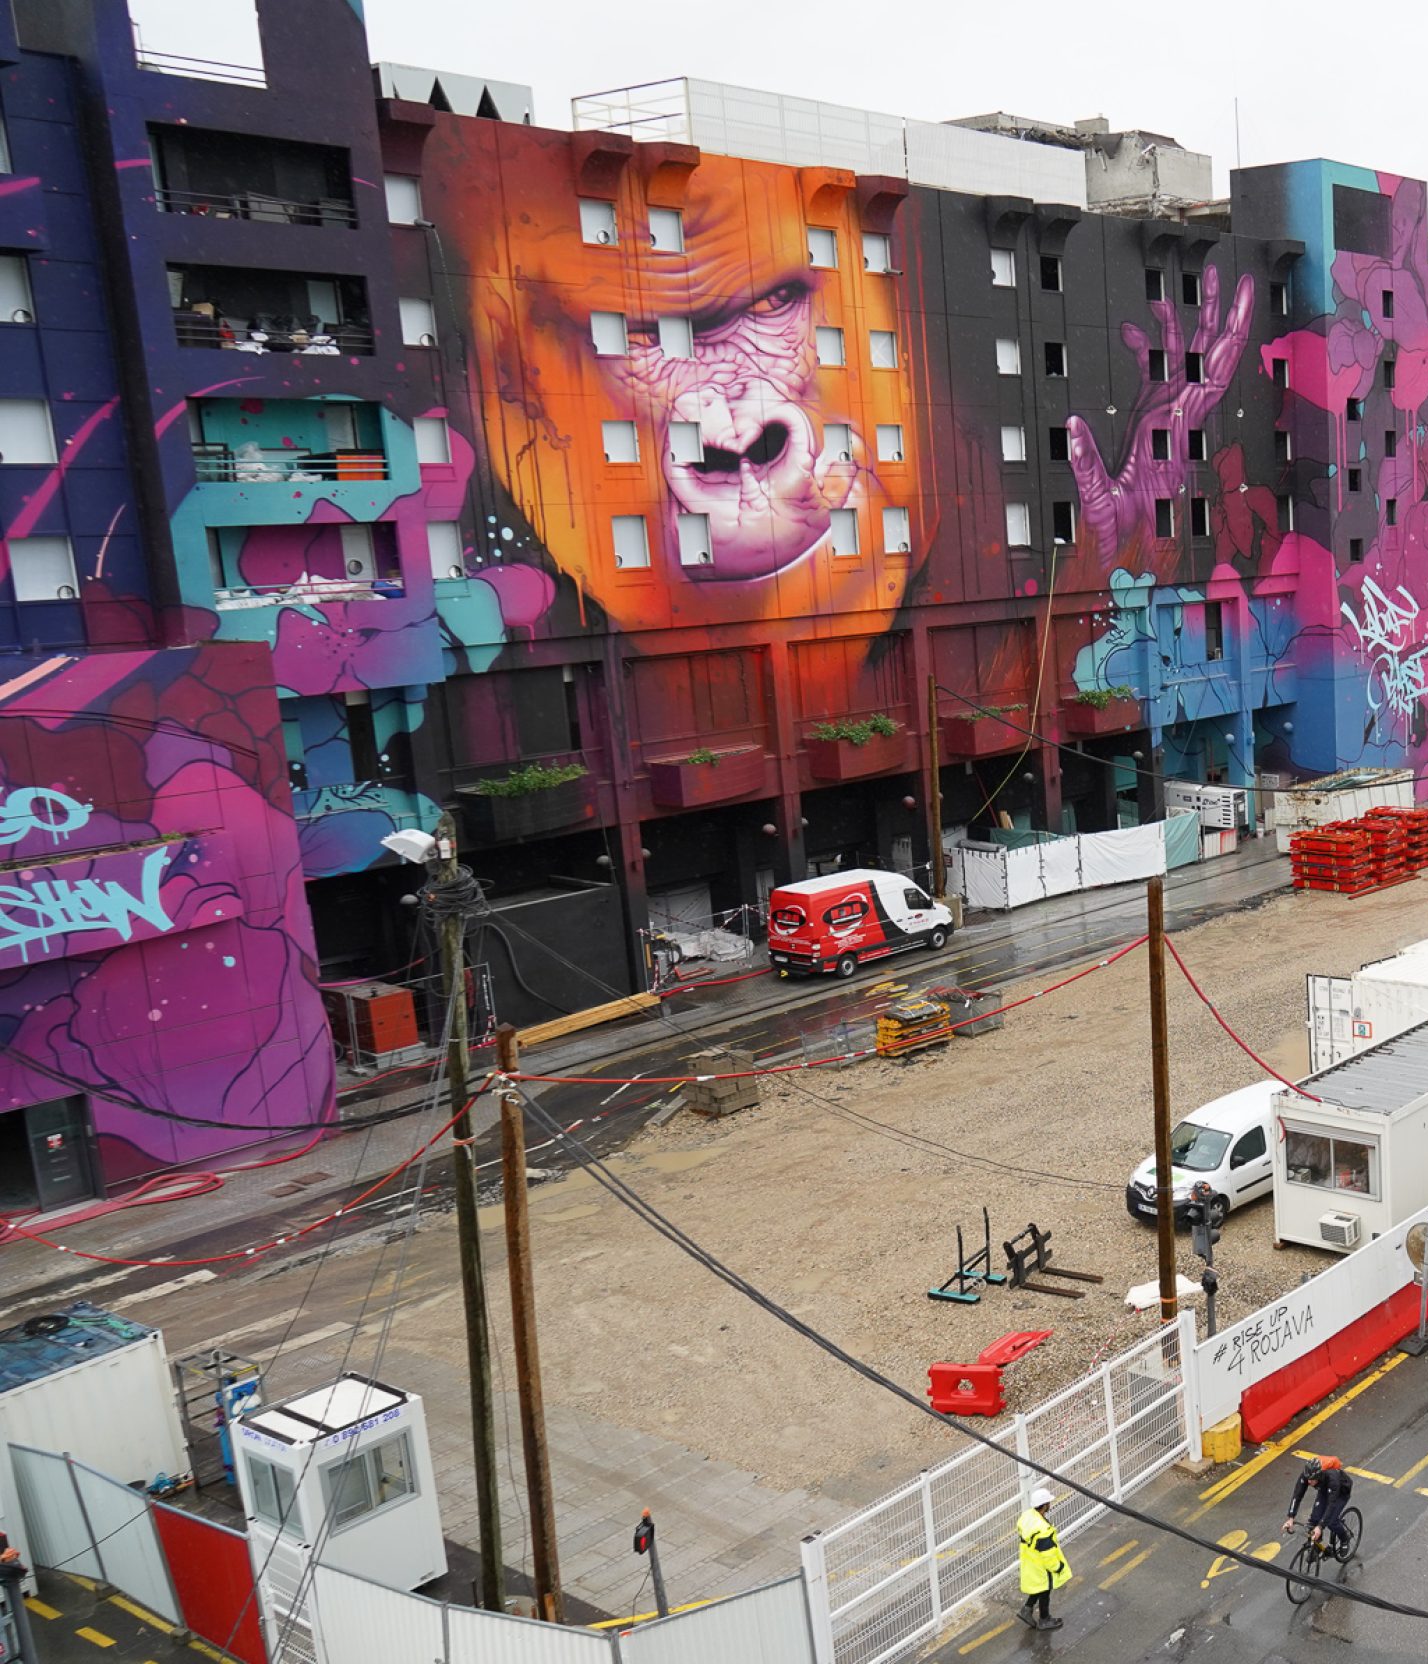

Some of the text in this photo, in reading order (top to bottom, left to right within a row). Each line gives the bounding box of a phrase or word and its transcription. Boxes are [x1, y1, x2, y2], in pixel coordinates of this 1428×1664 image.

[1227, 1304, 1314, 1375] 4 ROJAVA
[1232, 1319, 1264, 1351] RISE
[1270, 1306, 1288, 1328] UP
